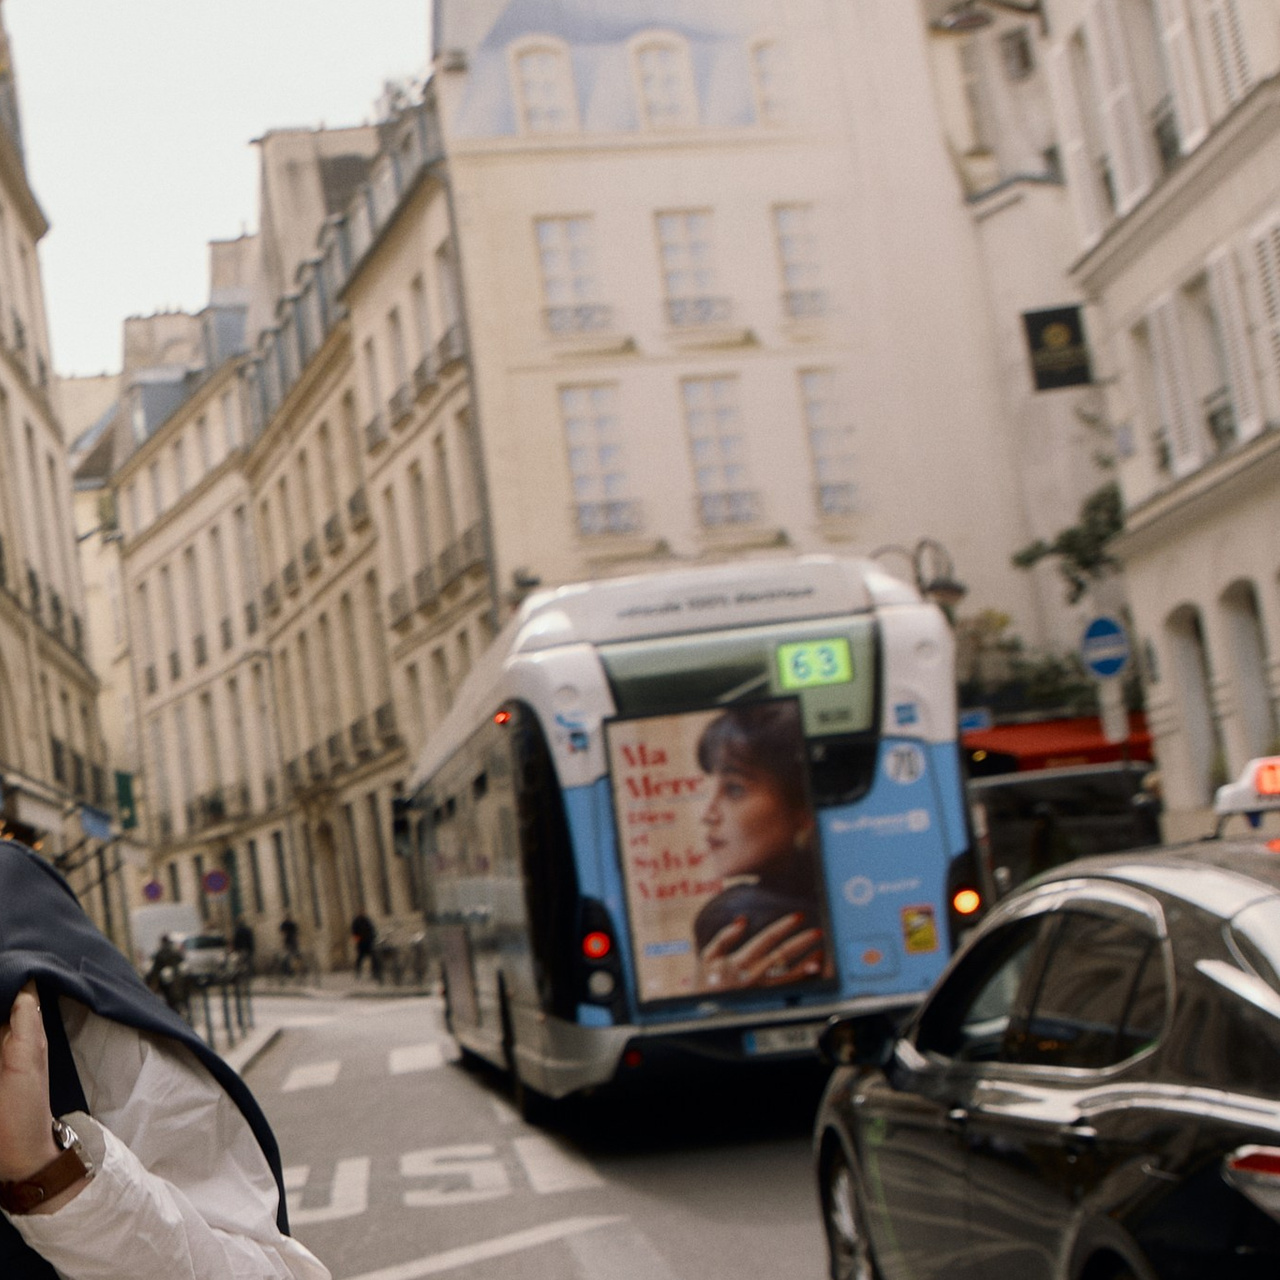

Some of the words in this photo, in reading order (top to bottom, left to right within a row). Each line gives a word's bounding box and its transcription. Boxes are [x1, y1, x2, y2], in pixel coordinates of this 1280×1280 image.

[790, 645, 839, 680] 63
[622, 743, 667, 767] Ma
[893, 749, 921, 780] 70
